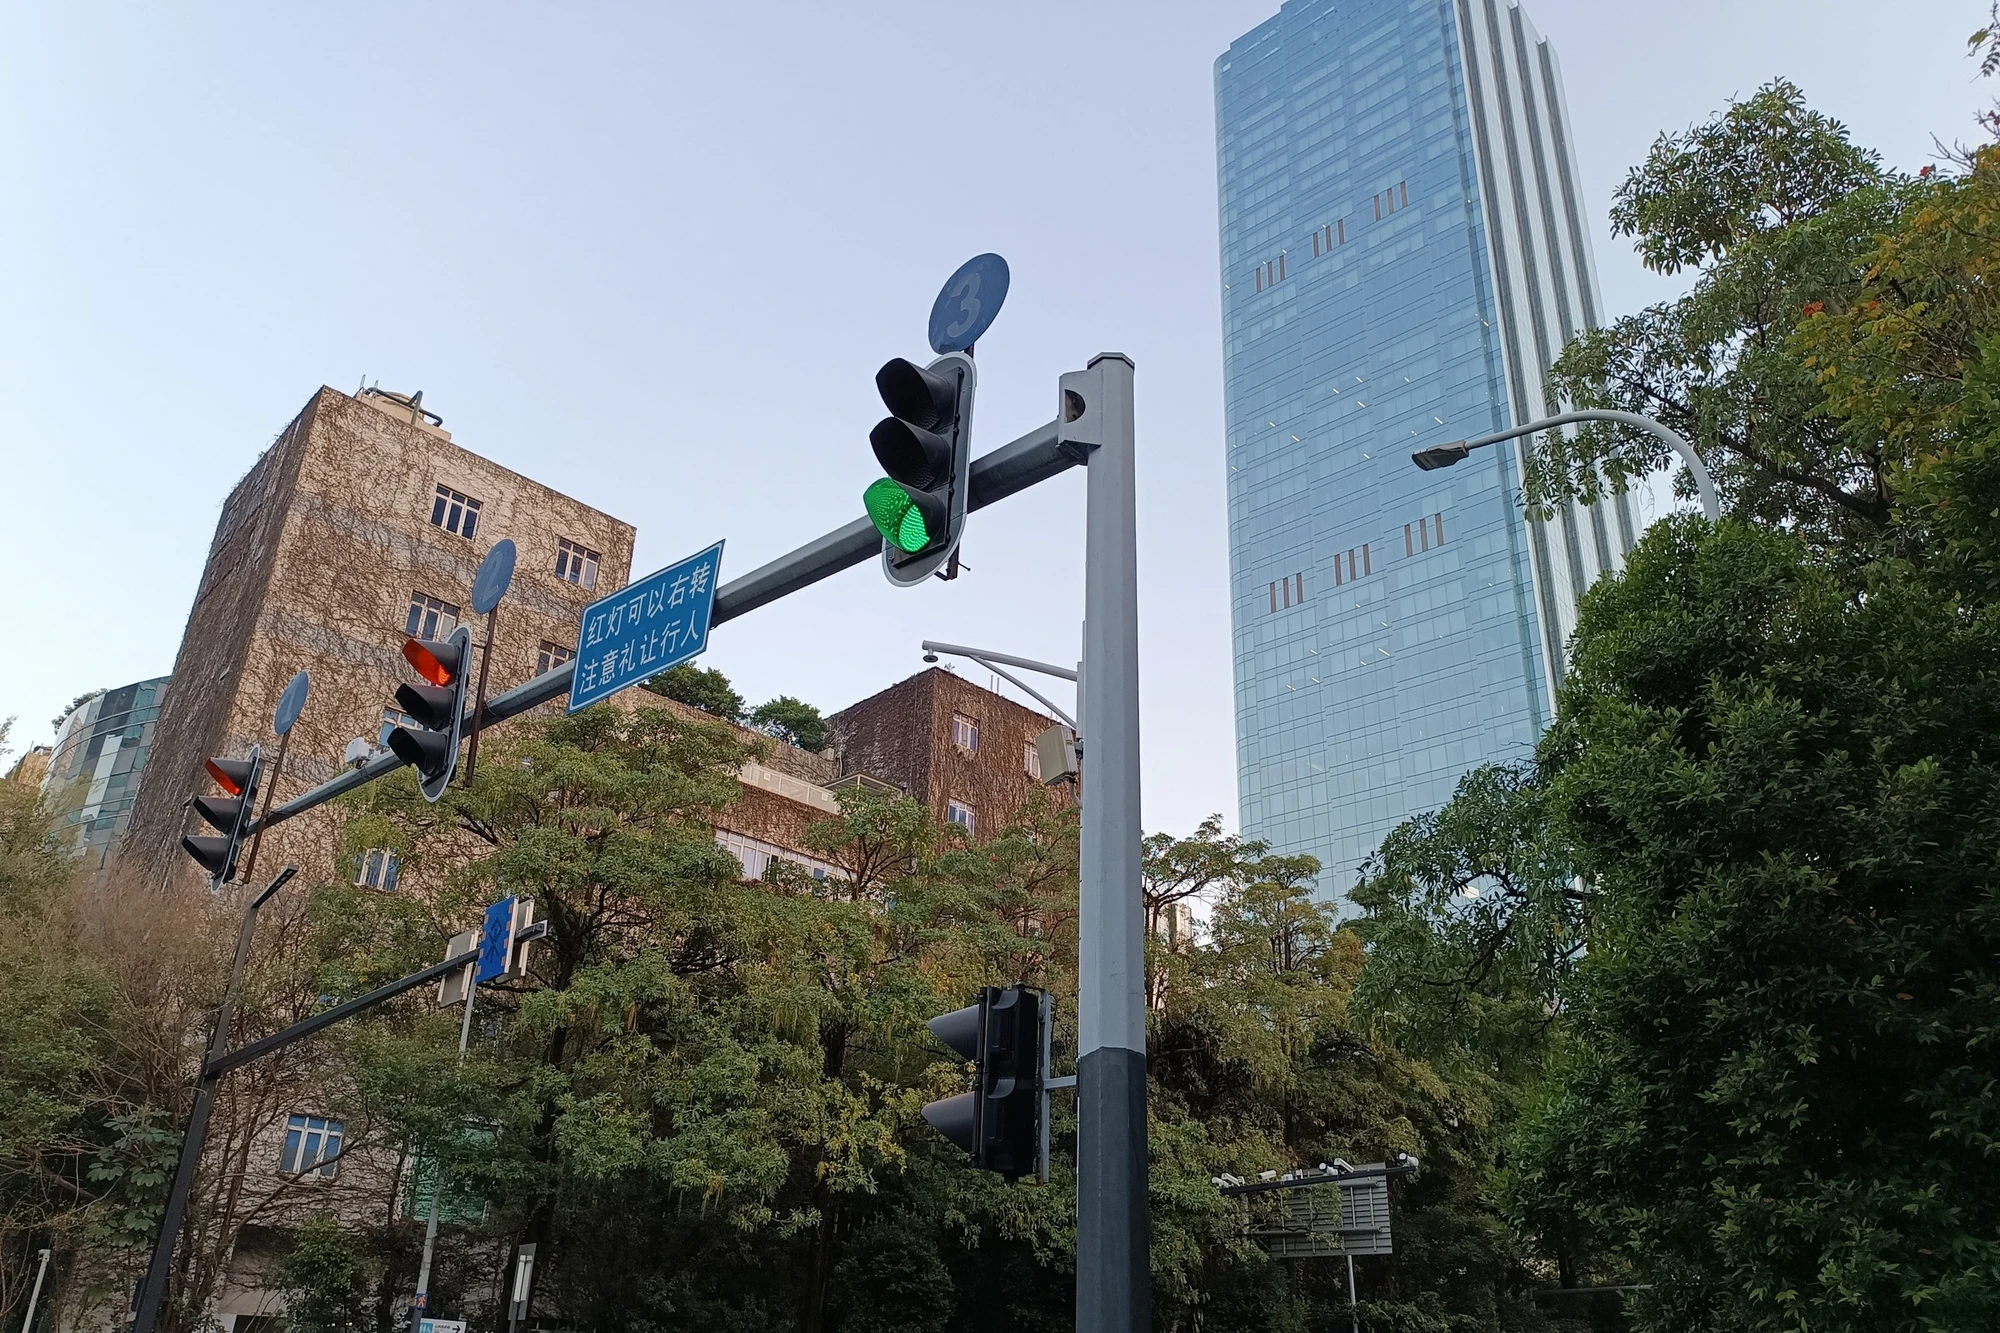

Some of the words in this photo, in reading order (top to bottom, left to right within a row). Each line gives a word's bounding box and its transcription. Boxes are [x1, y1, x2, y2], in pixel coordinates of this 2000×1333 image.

[946, 272, 981, 338] 3
[482, 550, 503, 603] 2
[585, 561, 711, 649] 红灯可以右转
[579, 609, 699, 695] 注意礼让行人
[281, 684, 298, 724] 1
